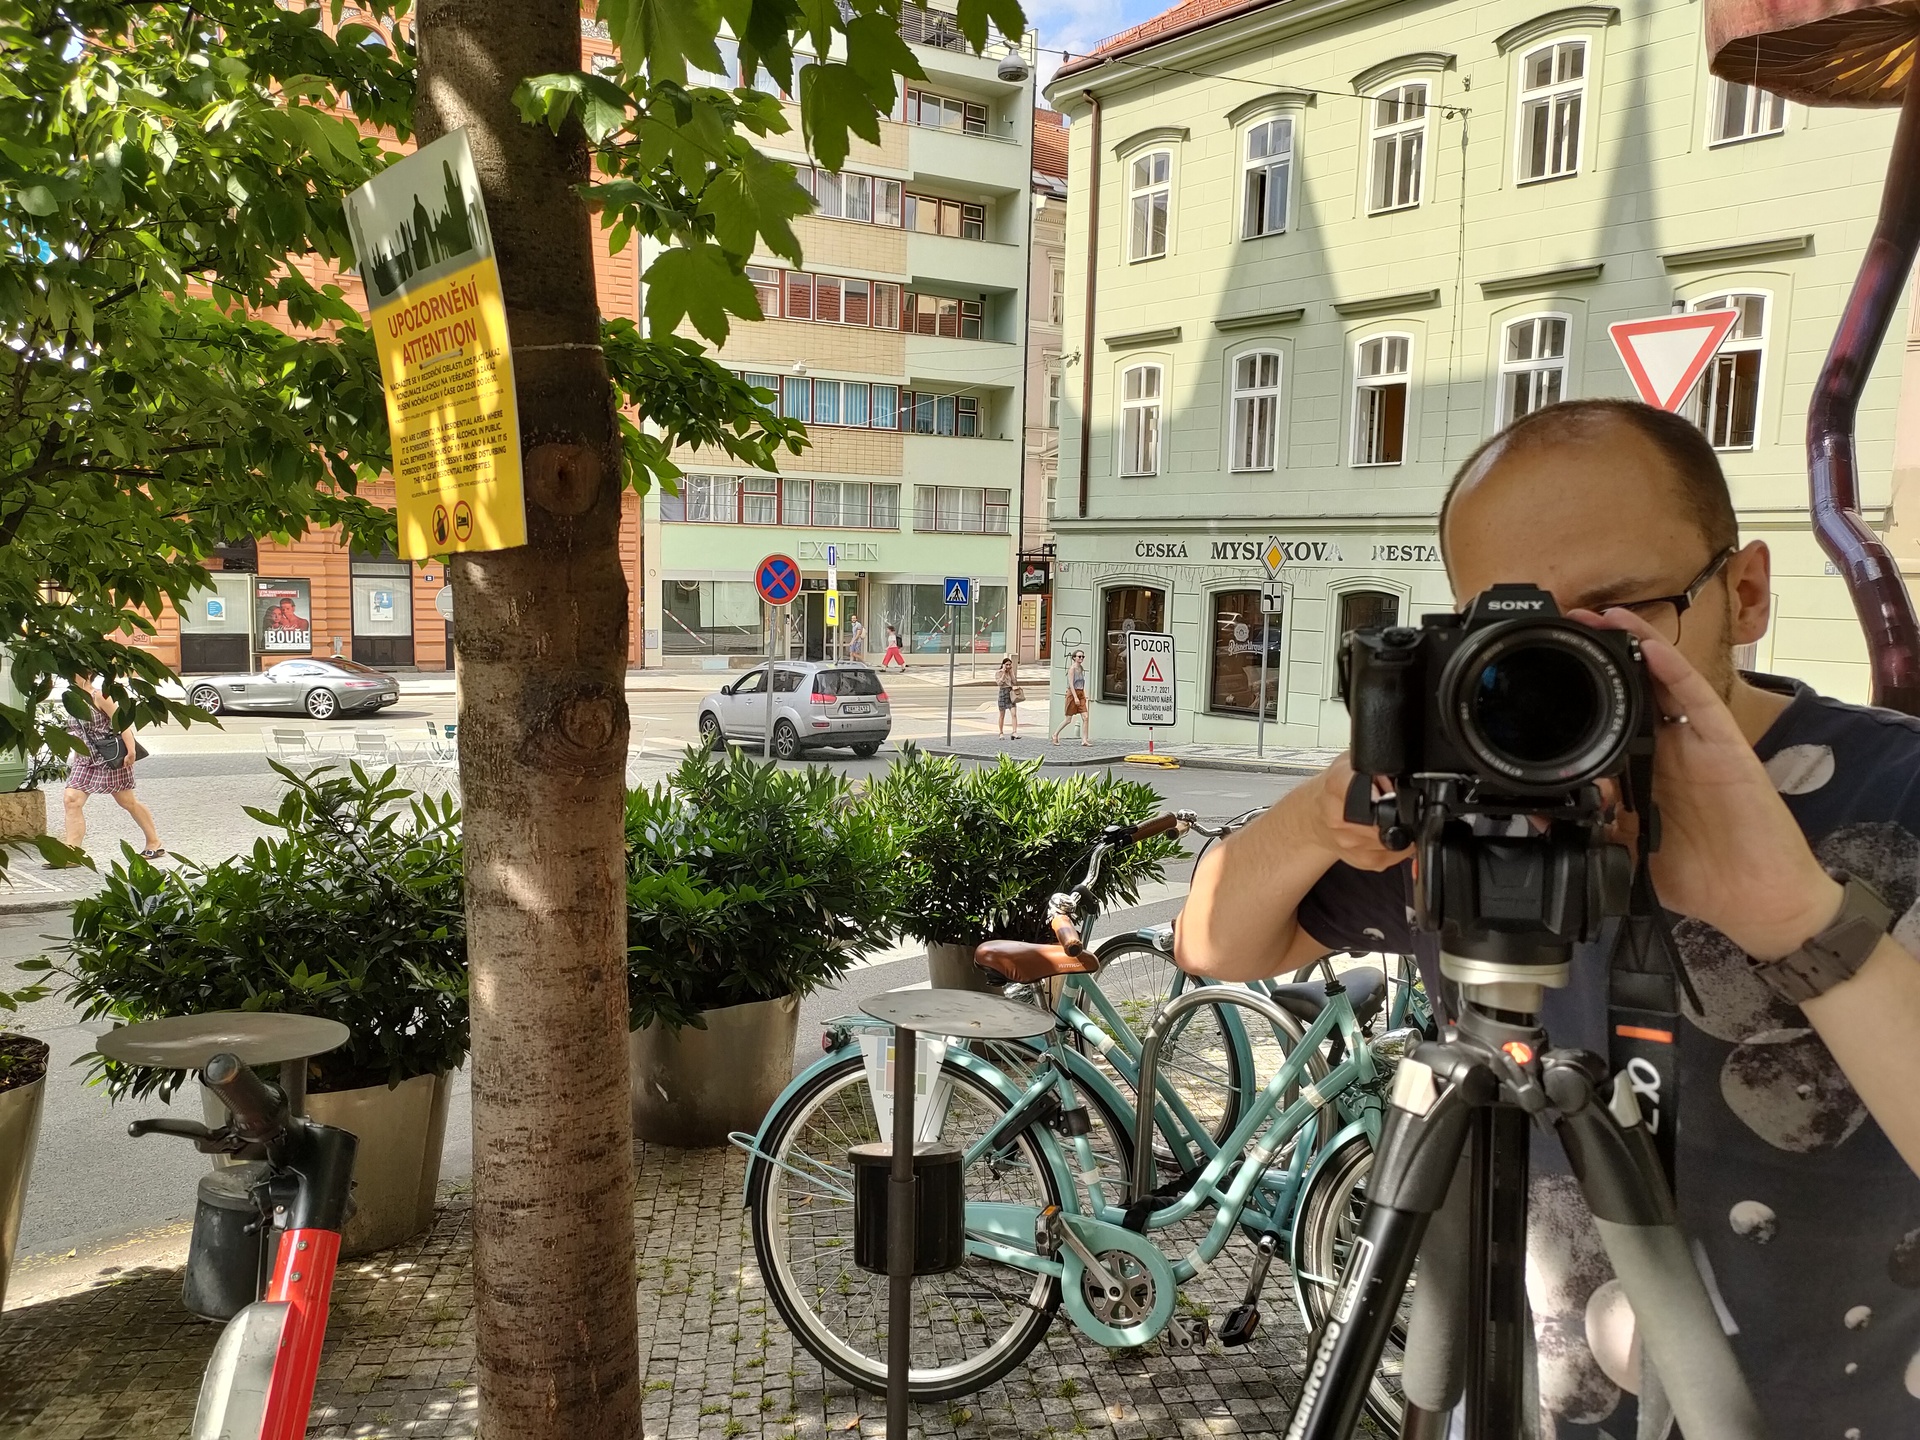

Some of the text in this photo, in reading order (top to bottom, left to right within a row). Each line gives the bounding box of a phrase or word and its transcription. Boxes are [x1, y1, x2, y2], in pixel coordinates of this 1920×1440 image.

[387, 274, 479, 339] UPOZORNĚNÍ
[403, 317, 478, 367] ATTENTION
[464, 357, 474, 367] KDE
[484, 348, 501, 360] ZÁKAZ
[396, 387, 421, 400] KONZUMACE
[441, 378, 449, 387] NA
[480, 362, 496, 373] ZÁKAZ
[443, 386, 456, 397] ČASE
[457, 384, 465, 393] OD
[465, 380, 477, 390] 22:00
[476, 378, 484, 387] DO
[444, 417, 473, 431] RESIDENTIAL
[474, 414, 486, 424] AREA
[487, 410, 503, 421] WHERE
[410, 441, 430, 452] FORBIDDEN
[456, 429, 478, 440] ALCOHOL
[410, 453, 427, 464] BETWEEN
[471, 439, 482, 448] AND
[402, 465, 421, 477] FORBIDDEN
[440, 454, 463, 467] EXCESSIVE
[463, 451, 477, 461] NOISE
[478, 446, 507, 459] DISTURBING
[413, 476, 421, 485] THE
[437, 465, 462, 479] RESIDENTIAL
[1135, 540, 1188, 558] ČESKÁ
[1488, 601, 1544, 610] SONY
[268, 629, 309, 643] BOUŘE
[1133, 639, 1170, 653] POZOR
[1132, 695, 1160, 703] MASARYKOVO
[1159, 686, 1170, 694] 2021
[1142, 713, 1163, 721] UZAVŘENO
